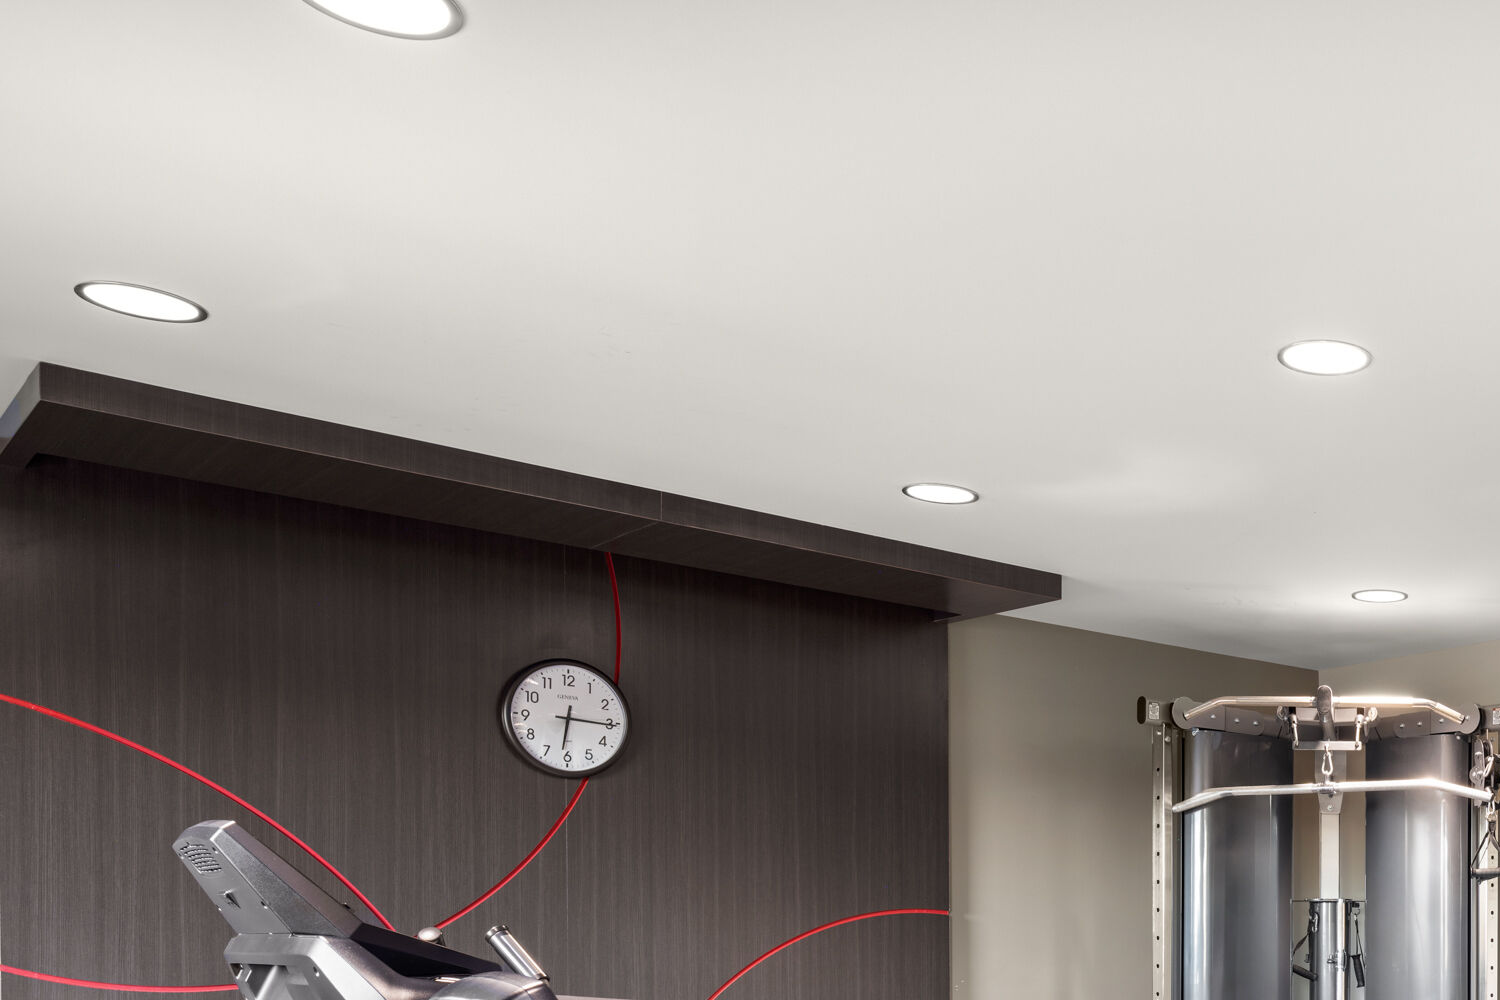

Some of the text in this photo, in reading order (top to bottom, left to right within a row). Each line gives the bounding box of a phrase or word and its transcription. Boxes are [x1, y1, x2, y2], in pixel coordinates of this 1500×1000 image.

[541, 677, 553, 690] 11
[561, 674, 576, 687] 12
[587, 682, 592, 694] 1
[525, 690, 540, 704] 10
[601, 699, 609, 711] 2
[520, 709, 530, 721] 9
[605, 718, 614, 730] 3
[526, 728, 535, 740] 8
[598, 735, 608, 748] 4
[543, 744, 551, 757] 7
[584, 749, 594, 761] 5
[563, 751, 572, 763] 6
